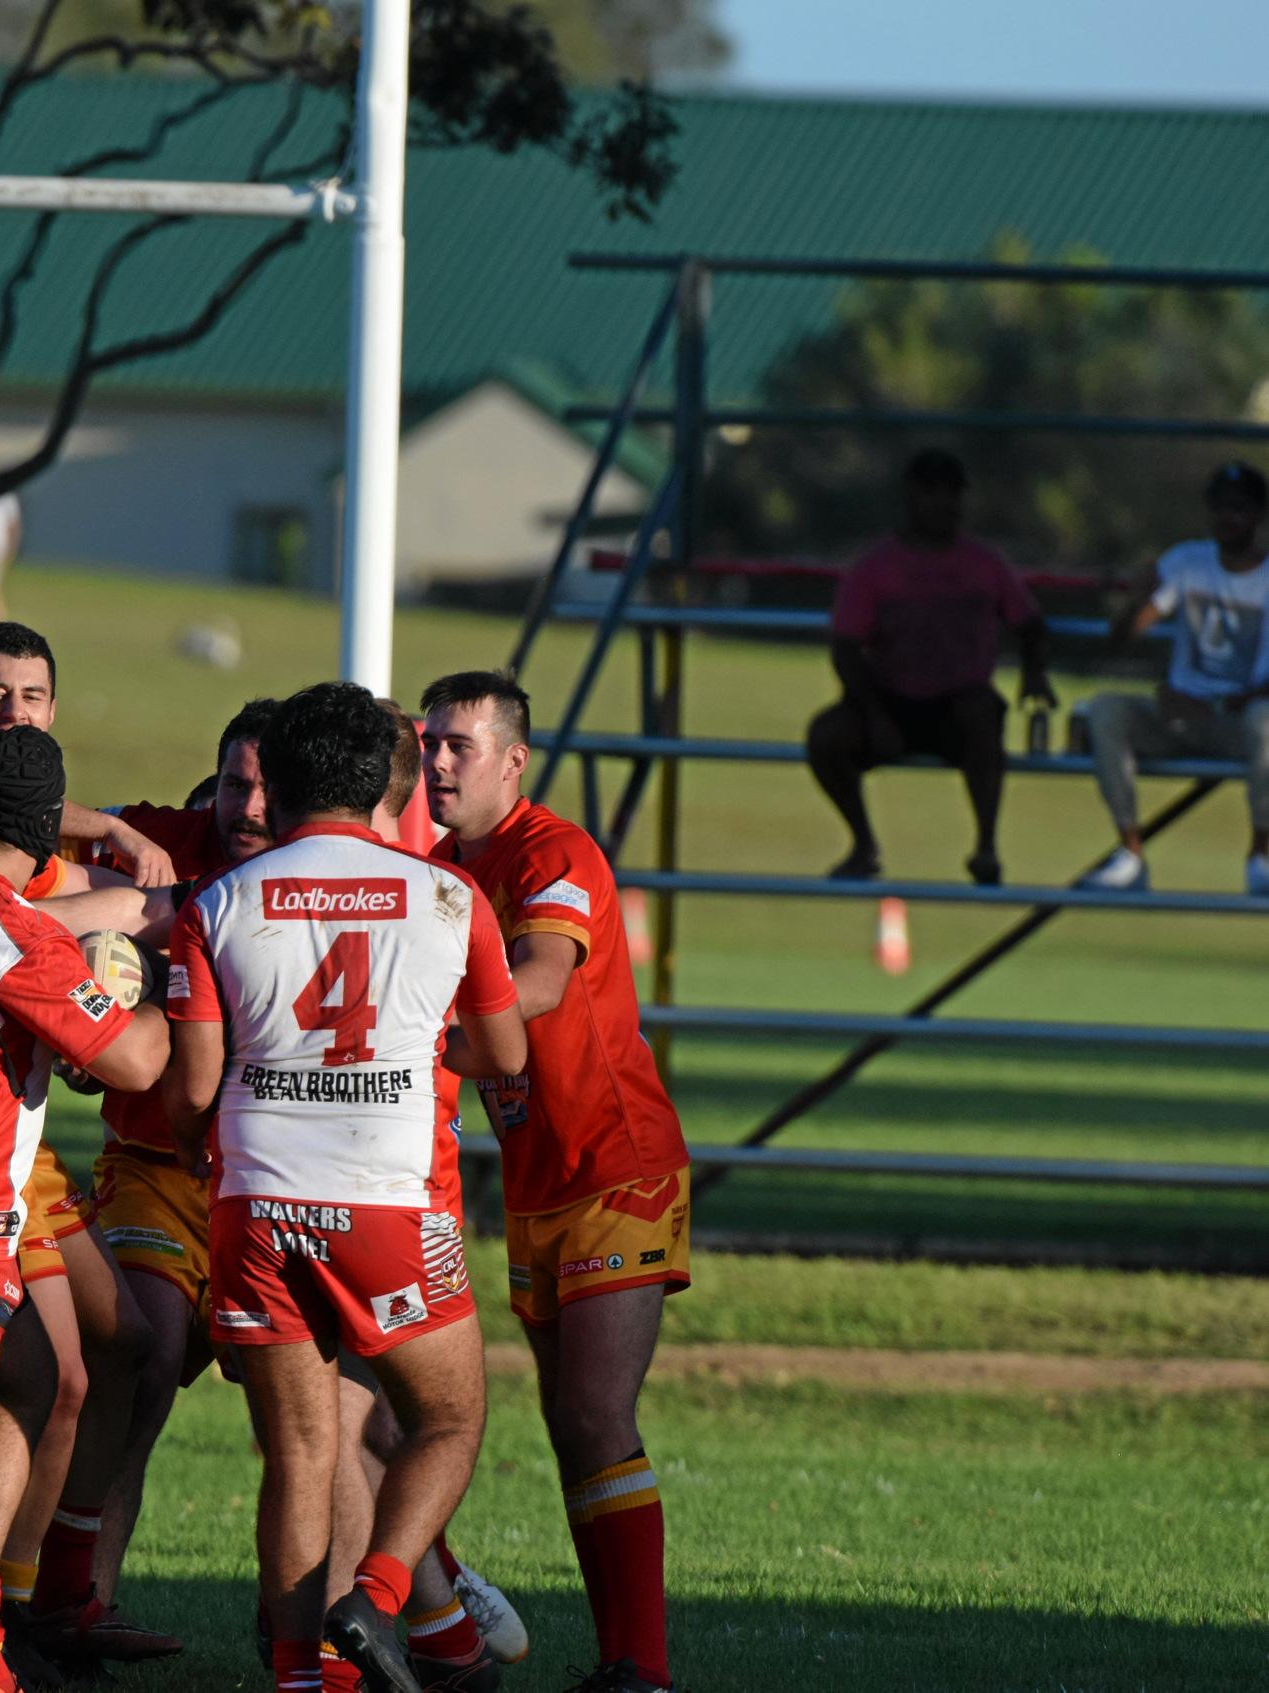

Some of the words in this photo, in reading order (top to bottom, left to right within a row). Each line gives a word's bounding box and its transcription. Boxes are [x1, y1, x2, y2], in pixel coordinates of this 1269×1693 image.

[271, 887, 398, 911] Ladbrokes
[292, 931, 377, 1066] 4
[240, 1063, 303, 1092] GREEN
[307, 1069, 412, 1094] BROTHERS
[61, 1191, 83, 1209] SPA
[639, 1248, 666, 1265] ZBR
